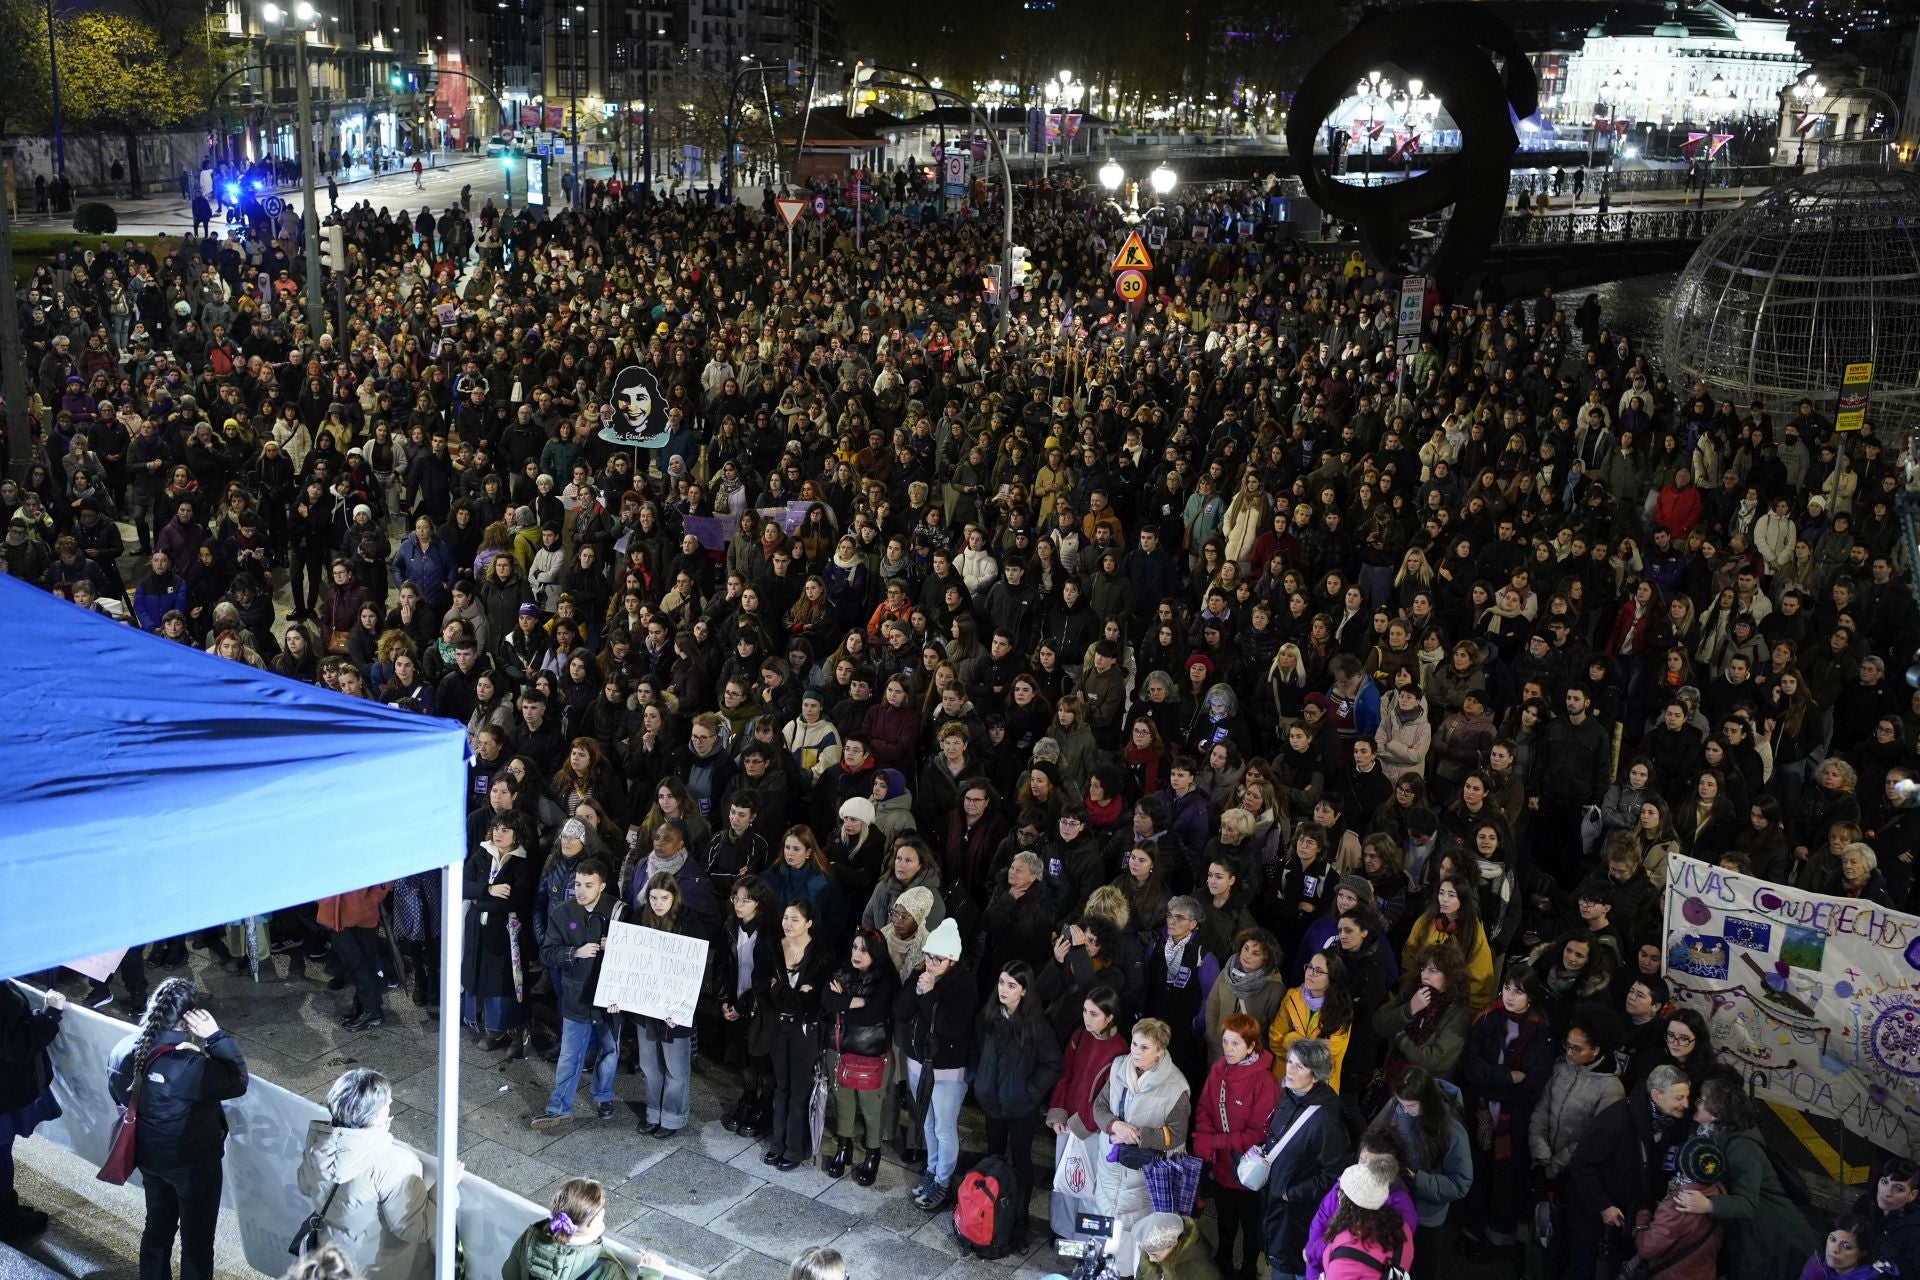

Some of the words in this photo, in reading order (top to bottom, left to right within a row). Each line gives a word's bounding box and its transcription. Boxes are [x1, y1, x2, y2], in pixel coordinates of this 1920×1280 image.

[1123, 281, 1140, 291] 30
[1667, 862, 1738, 903] VIVAS
[608, 949, 621, 965] TU
[628, 951, 654, 971] VIDA
[686, 940, 702, 960] EN
[1869, 993, 1913, 1013] MUJER
